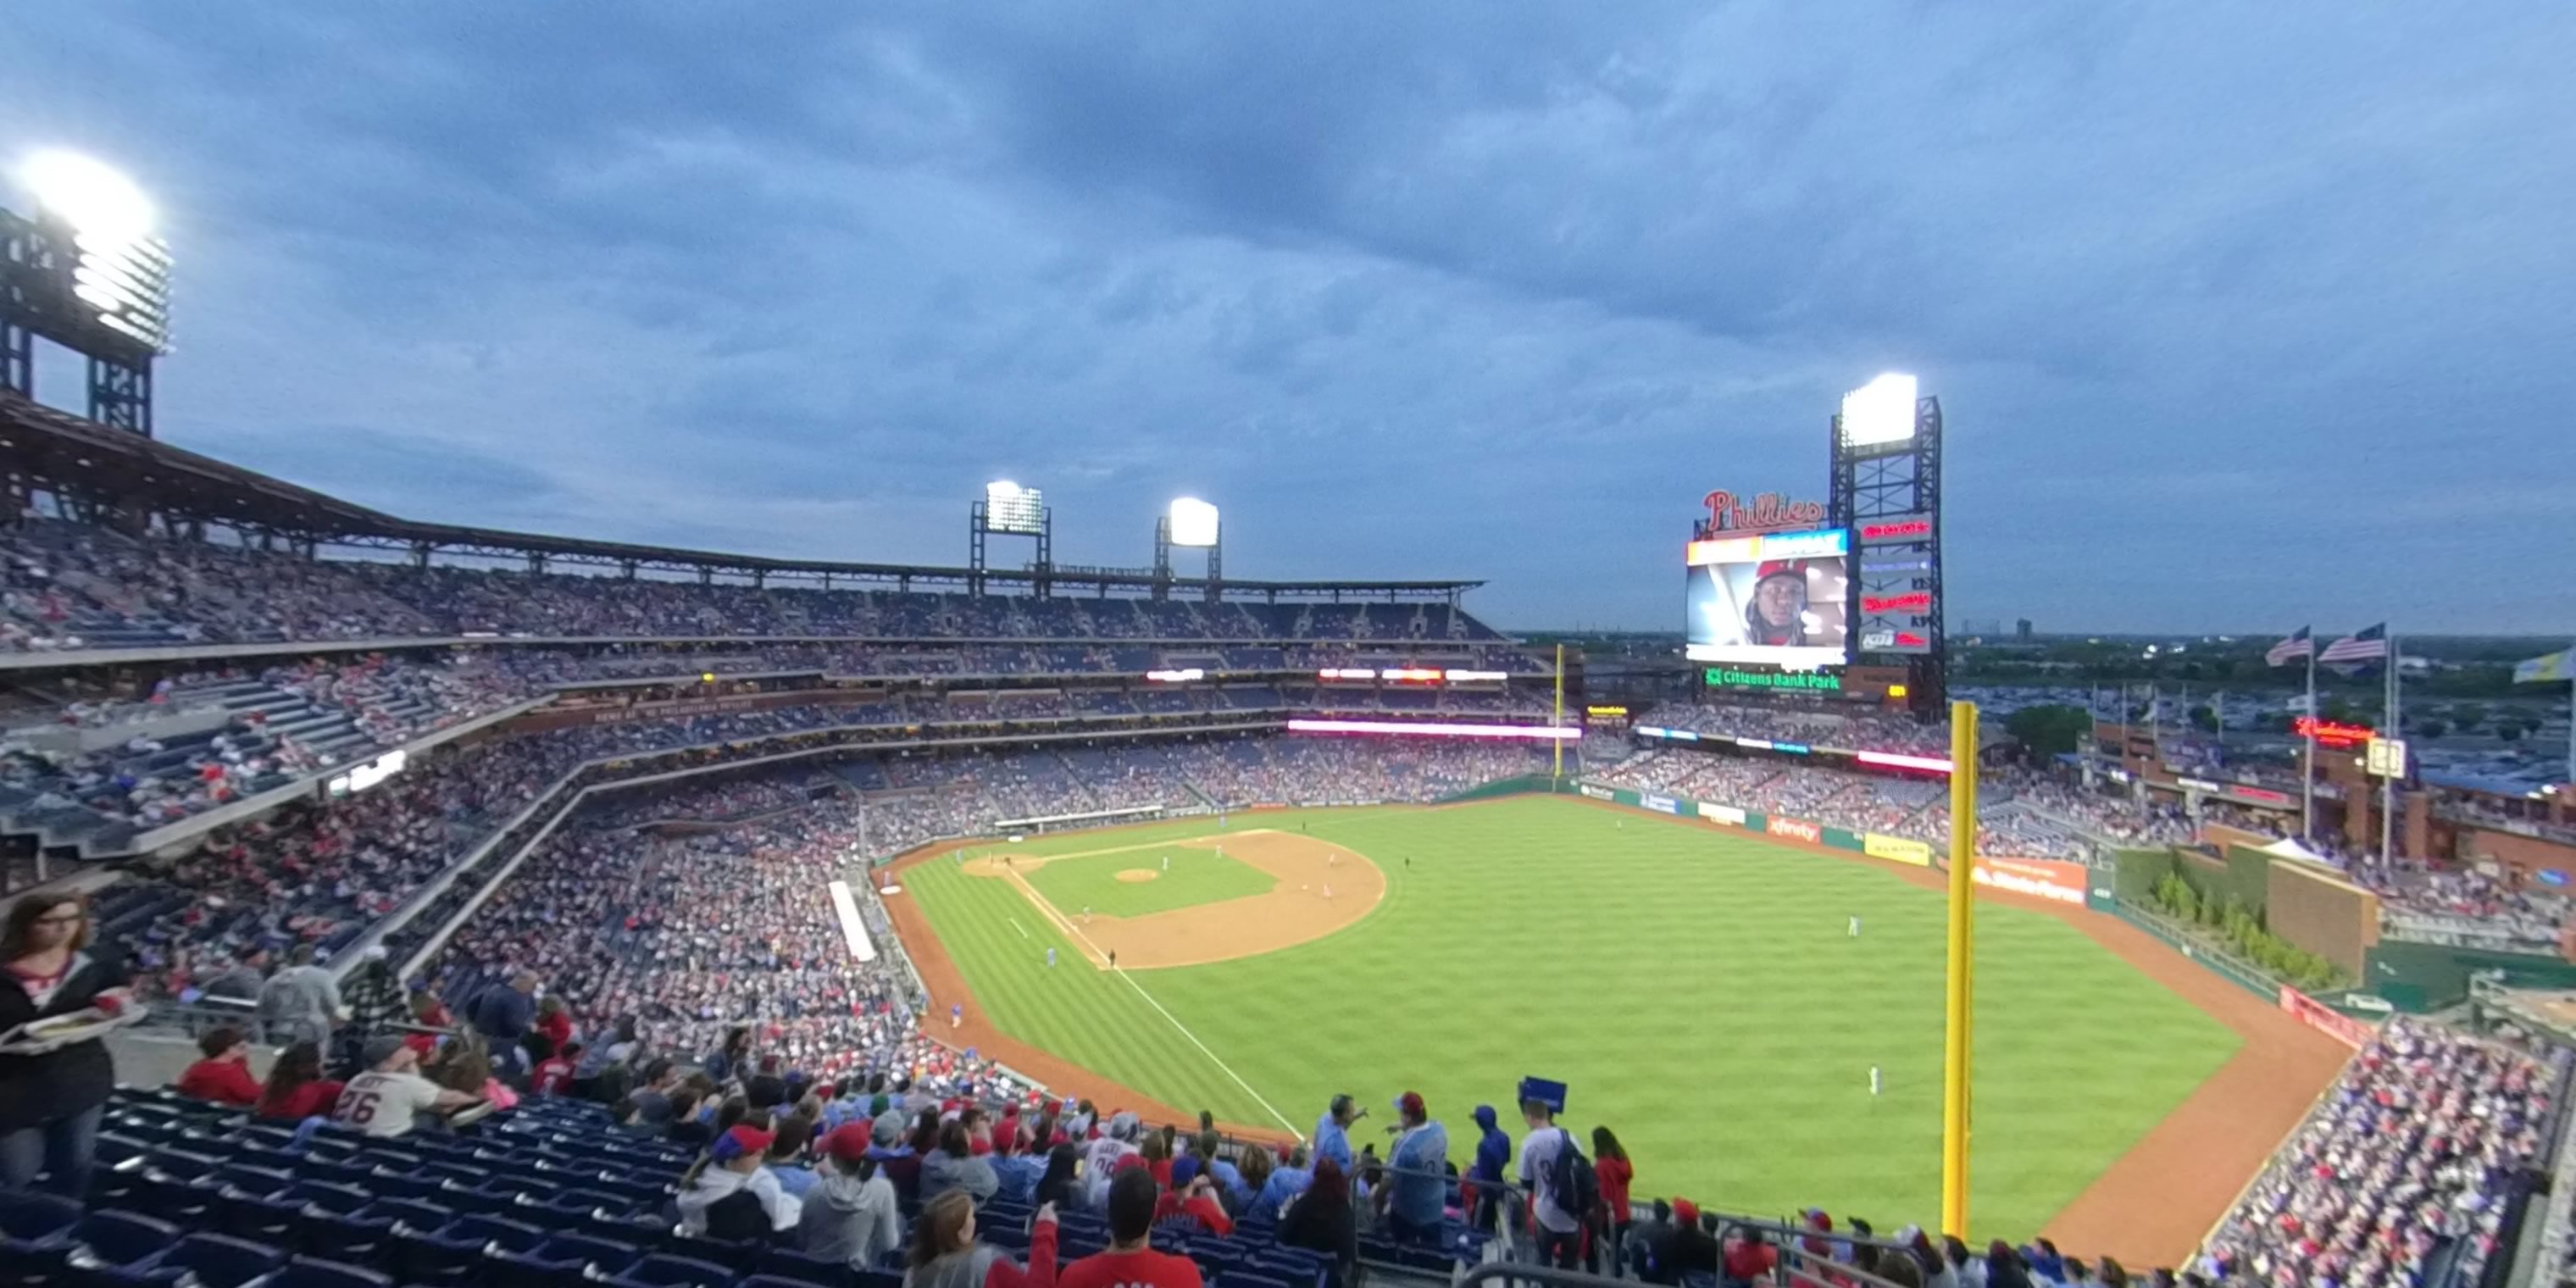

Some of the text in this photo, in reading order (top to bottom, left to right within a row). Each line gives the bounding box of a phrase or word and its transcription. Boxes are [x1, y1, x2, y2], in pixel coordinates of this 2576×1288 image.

[1703, 489, 1824, 531] Phillies
[1724, 670, 1839, 689] Citizens Bank Park
[1770, 817, 1818, 842] xfinity
[331, 1091, 382, 1124] 26
